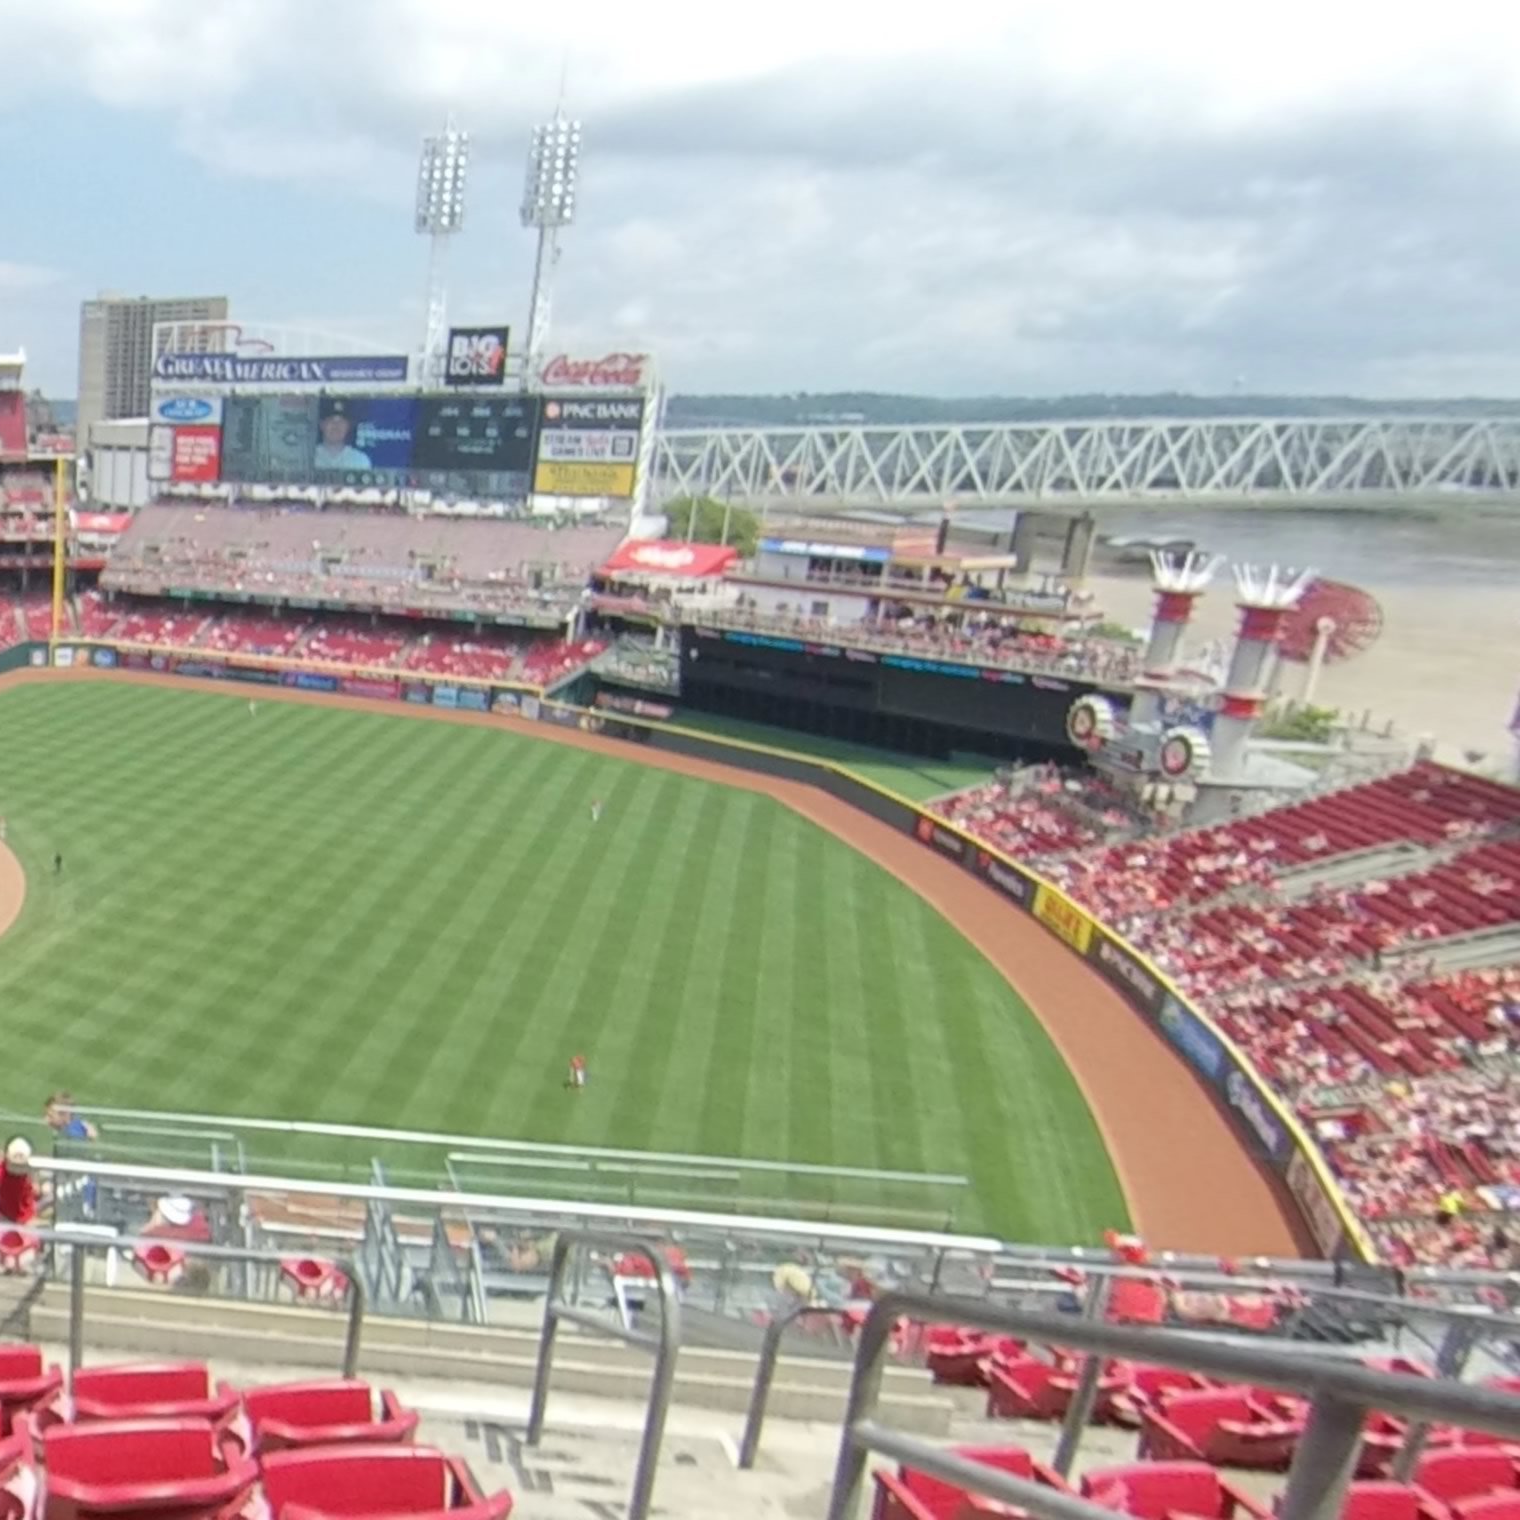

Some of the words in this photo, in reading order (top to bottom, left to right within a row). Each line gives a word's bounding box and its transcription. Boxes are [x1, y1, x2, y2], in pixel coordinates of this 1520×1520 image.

[451, 335, 500, 357] BIG
[156, 355, 227, 379] GREAT
[219, 357, 326, 381] AMERICAN
[543, 353, 649, 386] Coca-Cola
